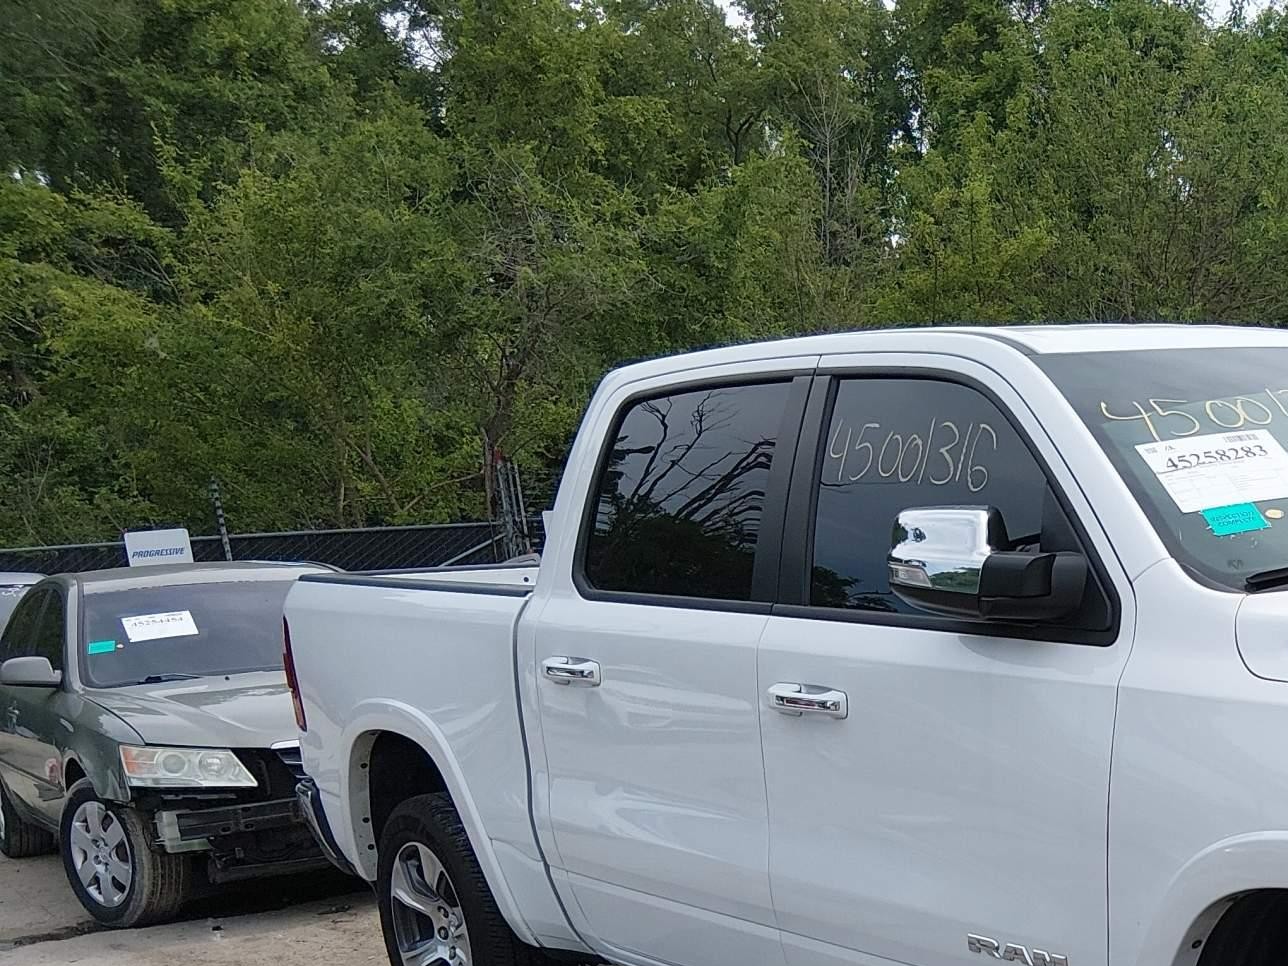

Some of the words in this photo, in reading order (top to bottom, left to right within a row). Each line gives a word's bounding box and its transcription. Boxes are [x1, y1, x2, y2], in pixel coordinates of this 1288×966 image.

[829, 416, 998, 492] 45001316
[1164, 444, 1269, 471] 45258283
[131, 547, 185, 559] PROGRESSIVE
